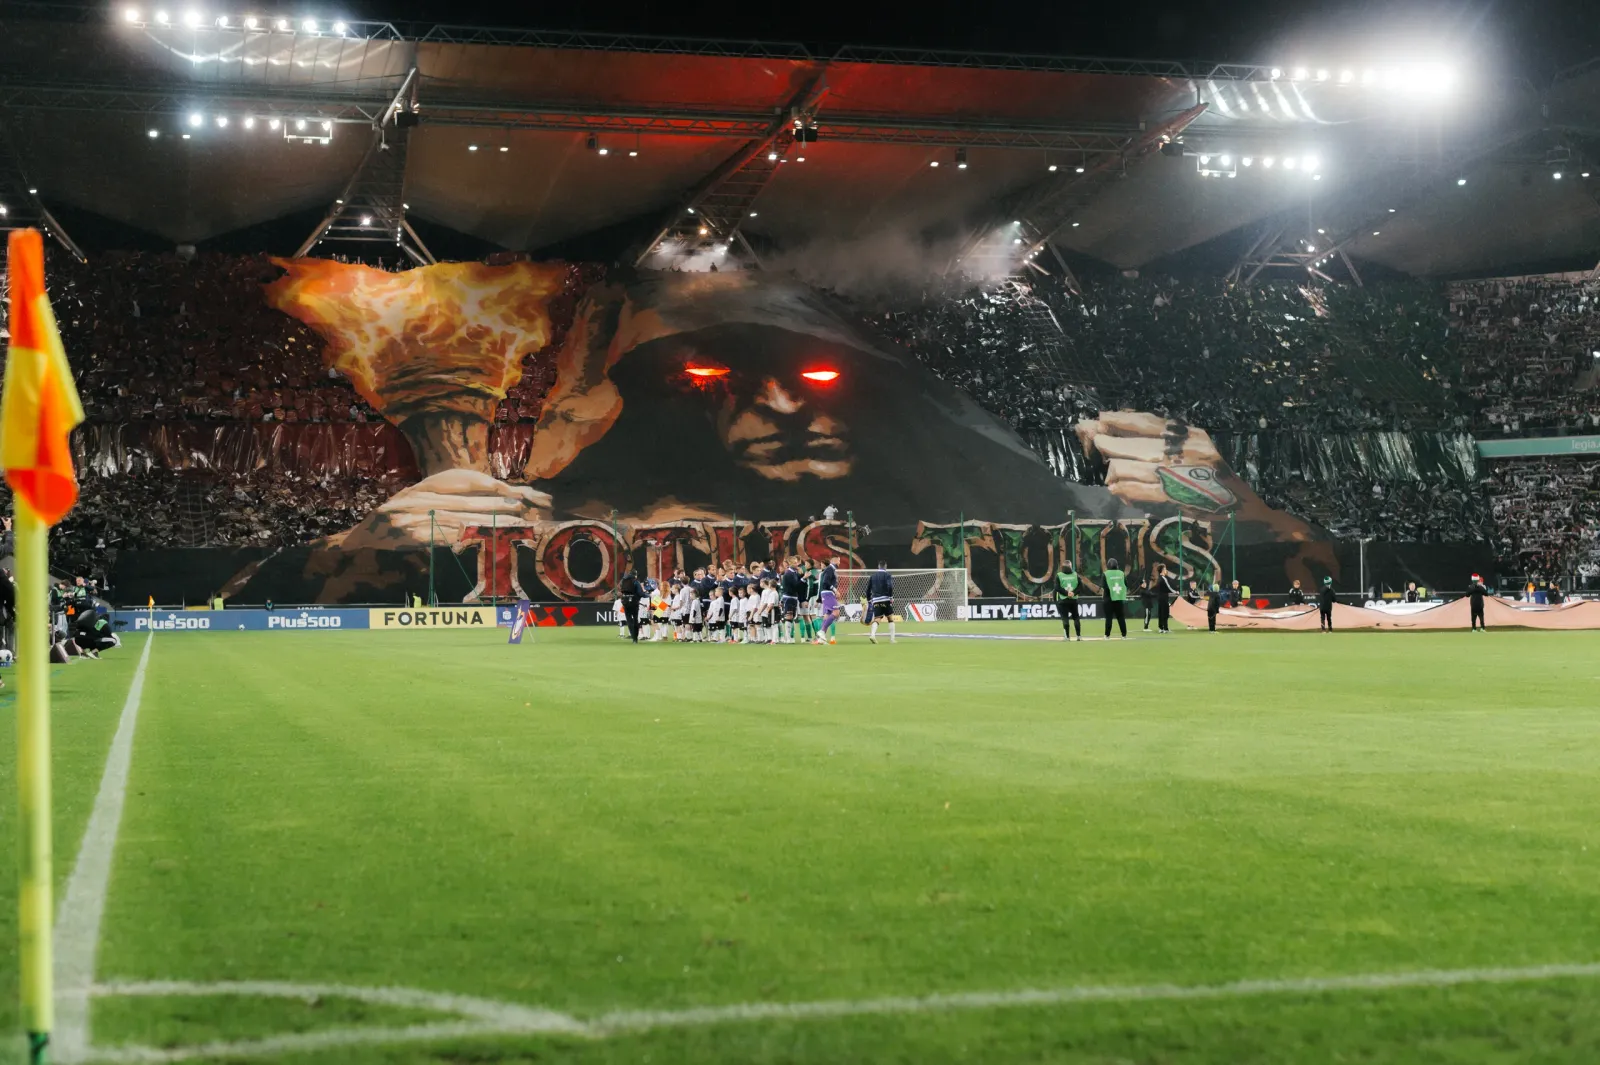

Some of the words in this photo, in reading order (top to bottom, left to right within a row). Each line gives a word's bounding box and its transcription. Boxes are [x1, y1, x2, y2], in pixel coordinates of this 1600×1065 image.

[1572, 439, 1600, 451] legia.
[911, 515, 1221, 600] TUUS
[135, 617, 210, 629] Plus500
[268, 616, 341, 628] Plus500
[384, 611, 483, 625] FORTUNA
